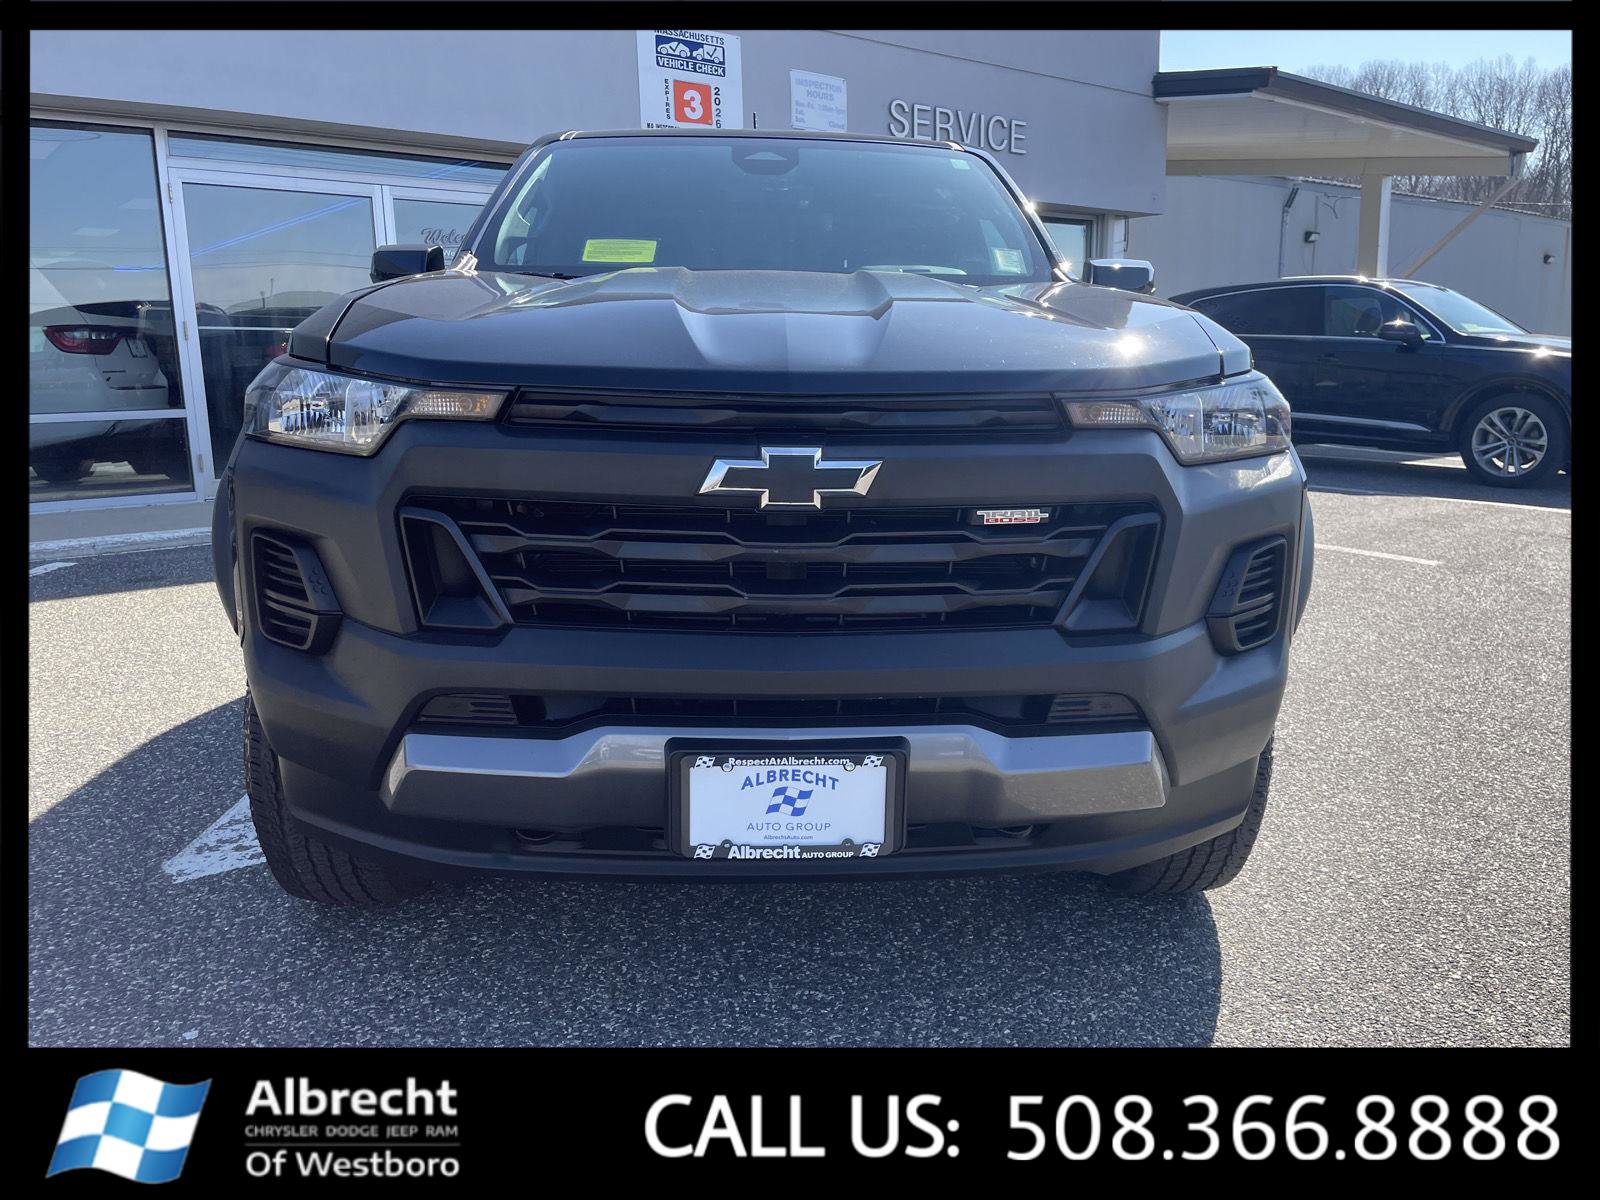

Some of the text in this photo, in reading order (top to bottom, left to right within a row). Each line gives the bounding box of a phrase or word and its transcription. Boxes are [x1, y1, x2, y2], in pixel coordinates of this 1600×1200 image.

[657, 56, 725, 77] VEHICLE CHECK
[683, 89, 704, 120] 3
[713, 86, 721, 129] 2026
[889, 99, 1027, 155] SERVICE
[977, 509, 1049, 518] TRAIL
[728, 756, 850, 767] RespectAtAlbrecht.com
[741, 769, 839, 790] ALBRECHT
[746, 822, 831, 831] AUTO GROUP
[727, 845, 801, 859] Albrecht
[825, 851, 854, 859] GROUP
